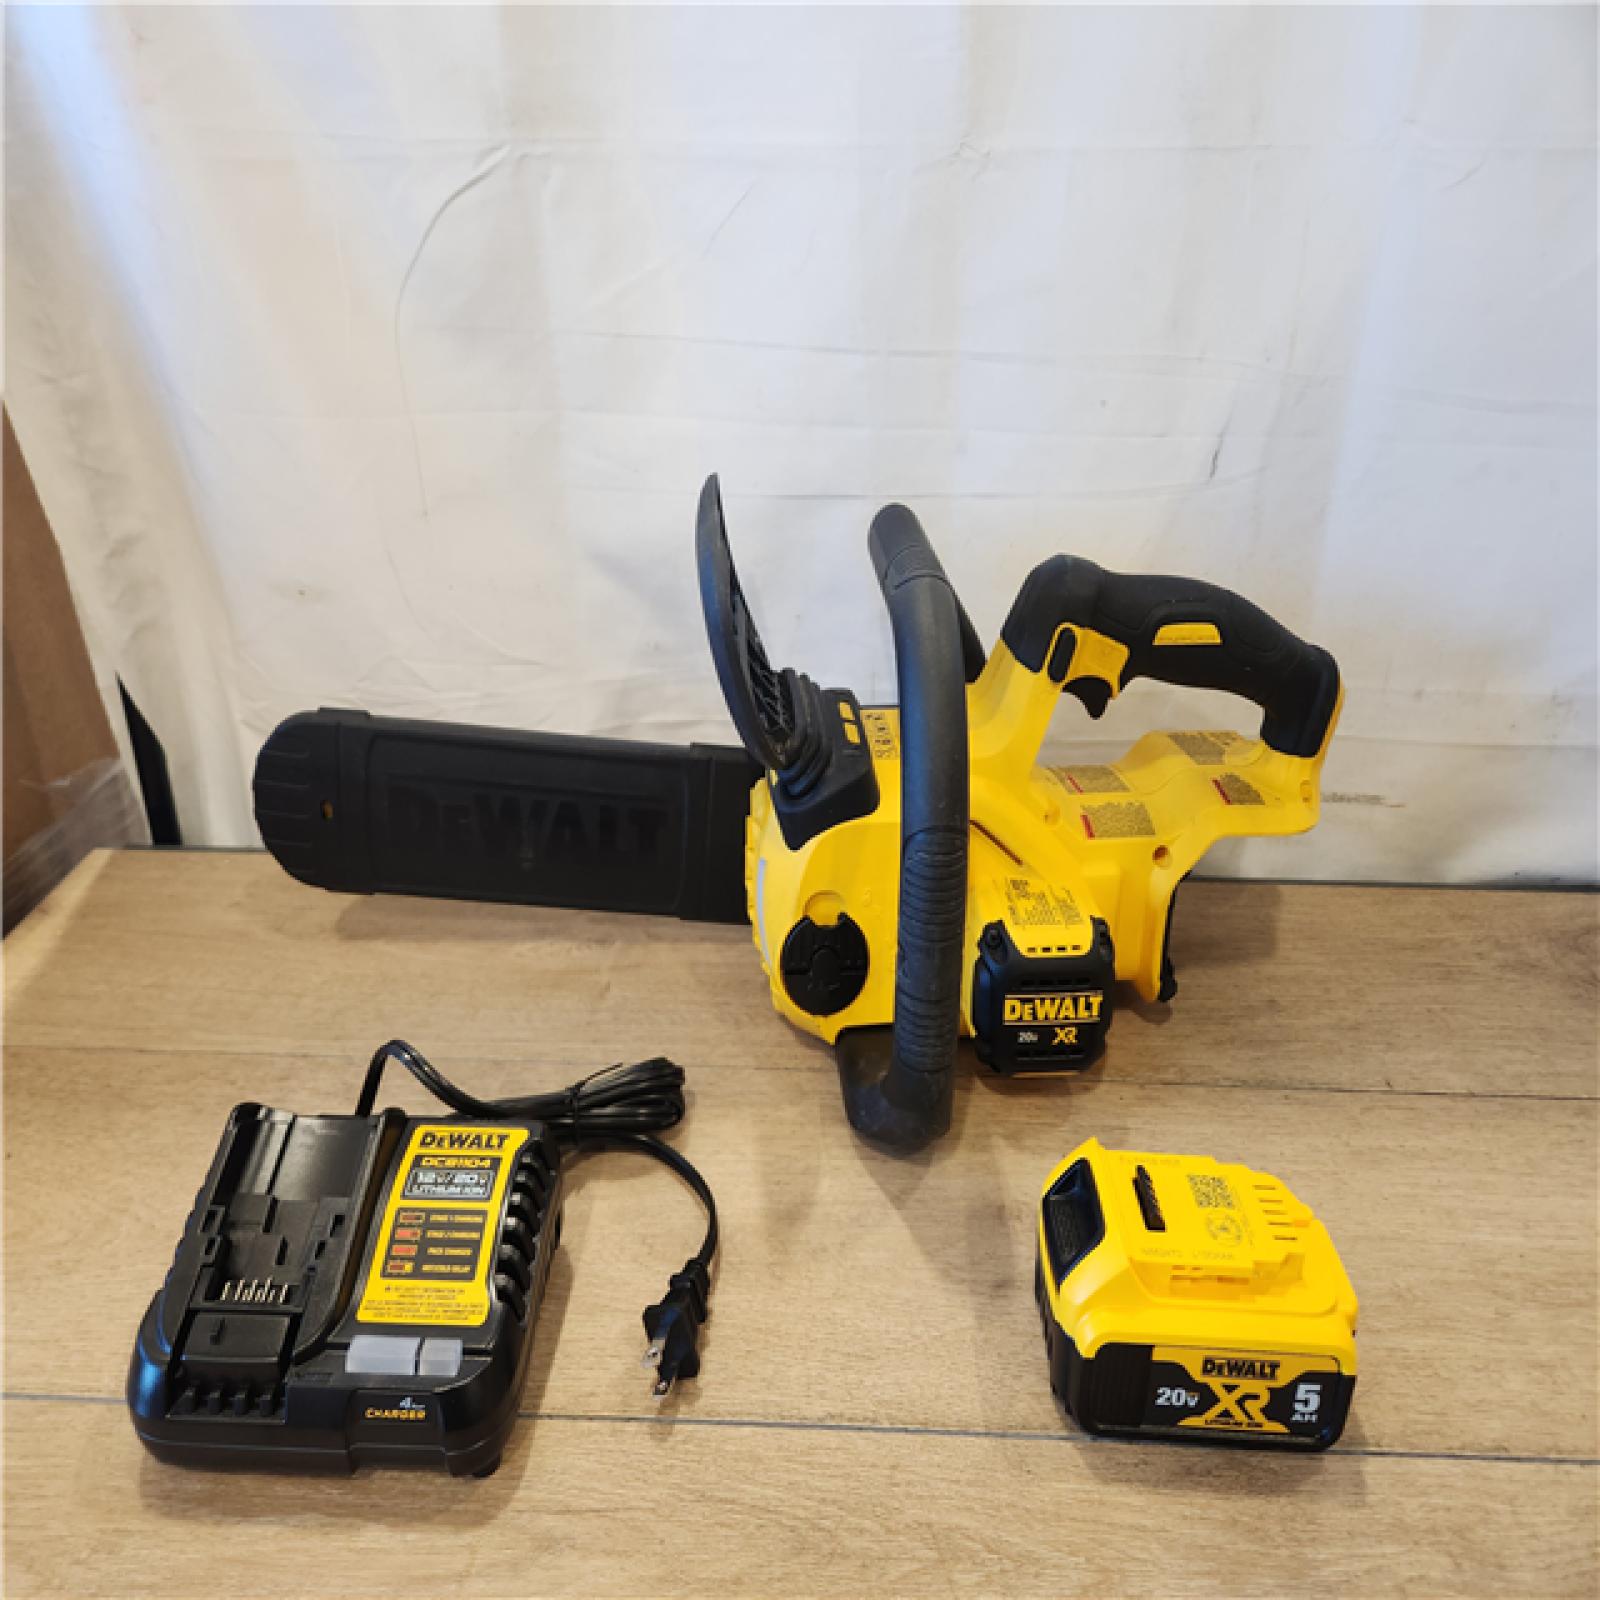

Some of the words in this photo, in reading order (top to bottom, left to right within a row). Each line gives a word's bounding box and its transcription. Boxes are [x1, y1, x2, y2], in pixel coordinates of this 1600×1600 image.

[365, 1408, 426, 1420] CHARGER
[1202, 1384, 1271, 1422] XR
[1295, 1384, 1322, 1413] 5
